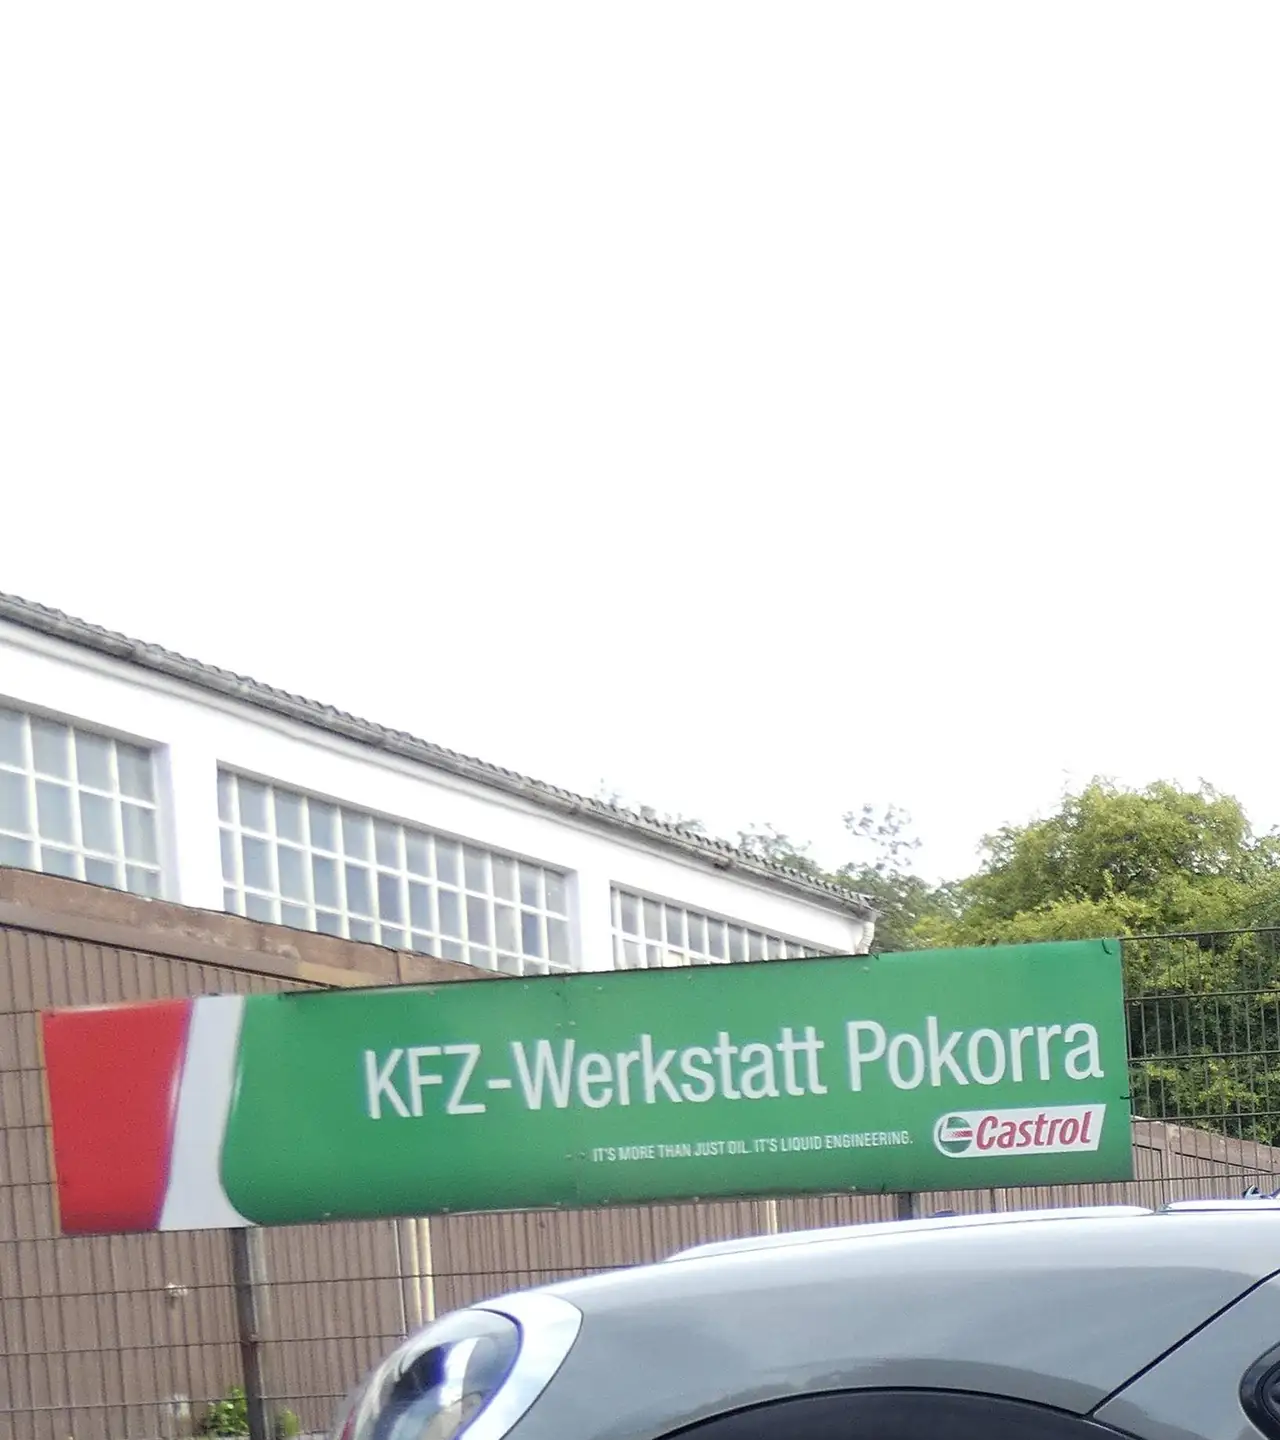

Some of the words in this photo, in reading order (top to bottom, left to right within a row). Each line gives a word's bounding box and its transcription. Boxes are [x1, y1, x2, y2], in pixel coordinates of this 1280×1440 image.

[364, 1026, 828, 1120] KFZ-Werkstatt
[846, 1016, 1105, 1092] Pokorra
[593, 1147, 617, 1162] IT'S
[618, 1145, 656, 1161] MORE
[657, 1143, 692, 1159] THAN
[694, 1141, 725, 1157] JUST
[755, 1137, 779, 1153] IT'S
[780, 1135, 822, 1152] LIQUID
[825, 1130, 914, 1150] ENGINEERING.
[975, 1110, 1093, 1151] Castrol
